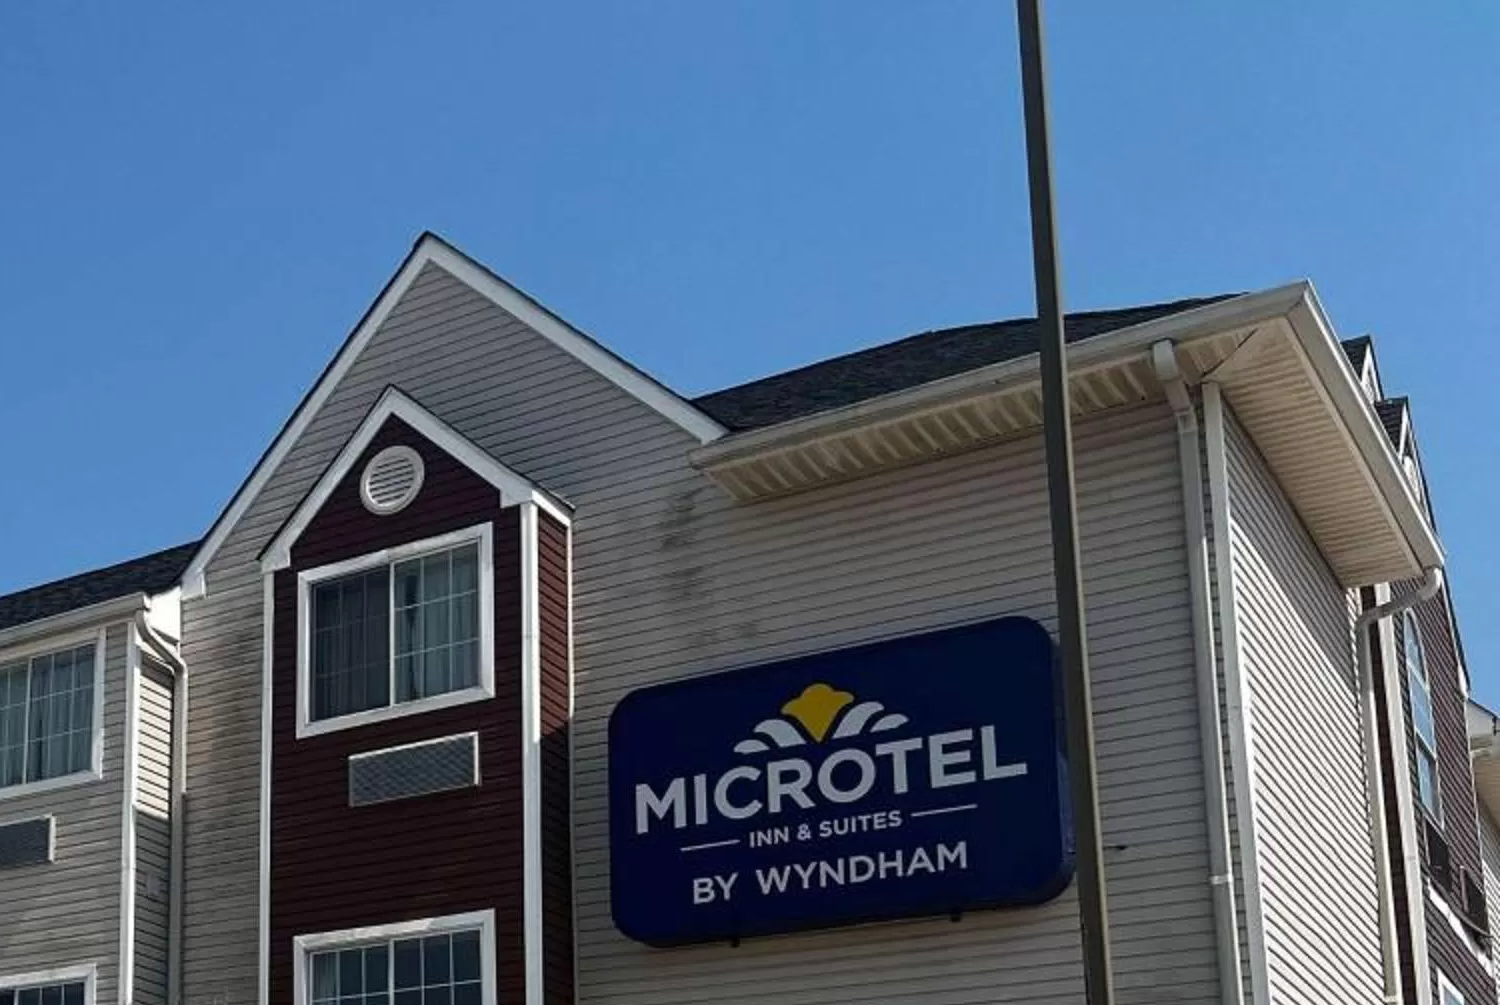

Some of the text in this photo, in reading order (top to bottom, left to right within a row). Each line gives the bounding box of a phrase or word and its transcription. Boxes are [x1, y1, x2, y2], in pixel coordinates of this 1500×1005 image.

[635, 725, 1028, 835] MICROTEL
[748, 809, 903, 849] INN & SUITES
[692, 840, 968, 904] BY WYNDHAM
